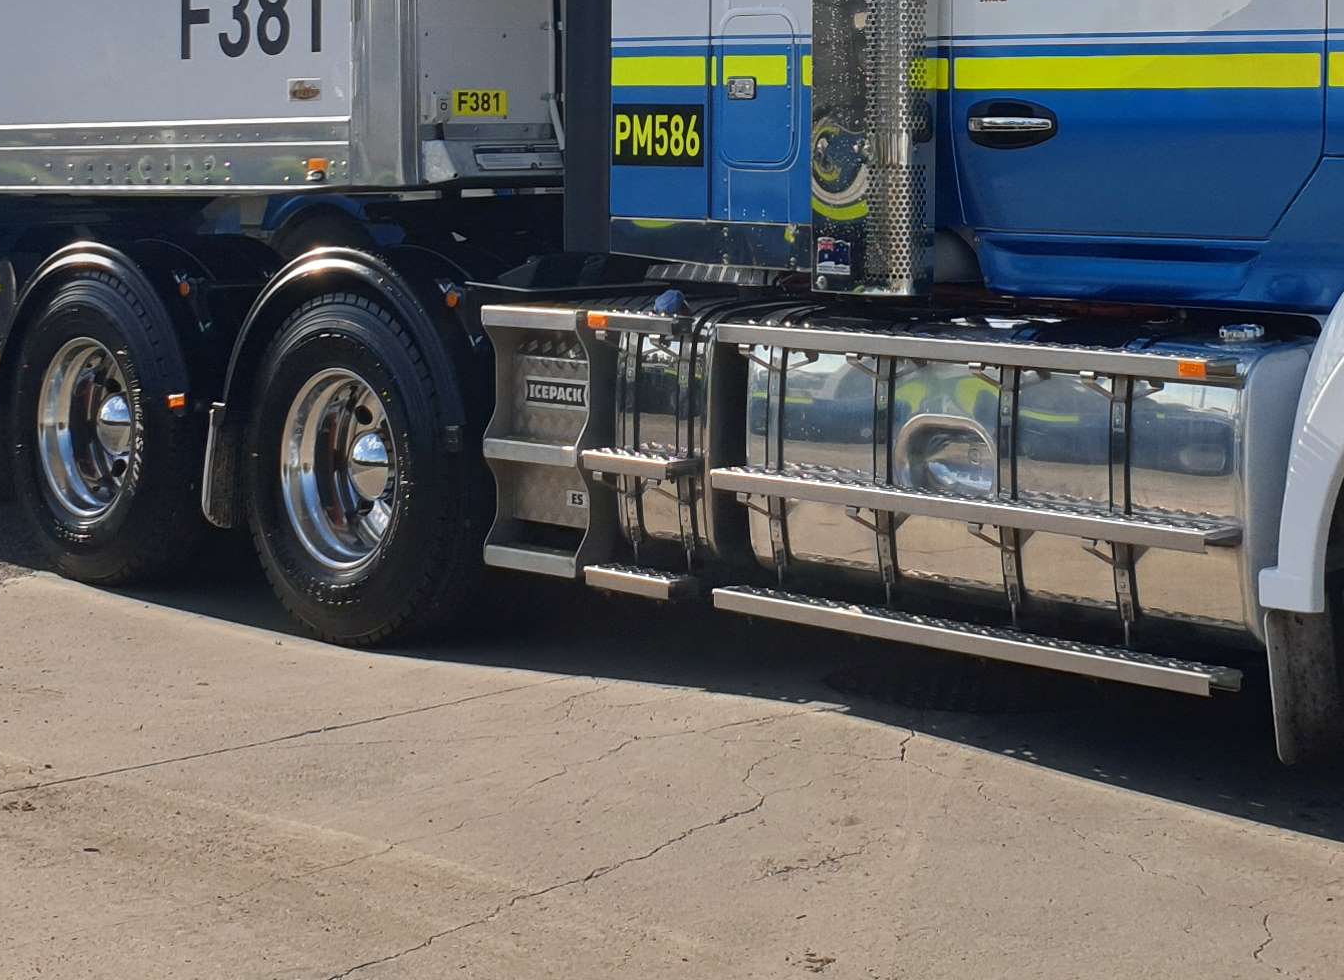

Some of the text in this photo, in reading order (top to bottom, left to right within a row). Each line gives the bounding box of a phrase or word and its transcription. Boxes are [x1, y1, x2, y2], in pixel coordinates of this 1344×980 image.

[457, 91, 501, 112] F381
[614, 114, 701, 158] PM586
[529, 384, 583, 402] ICEPACK
[571, 493, 584, 506] ES
